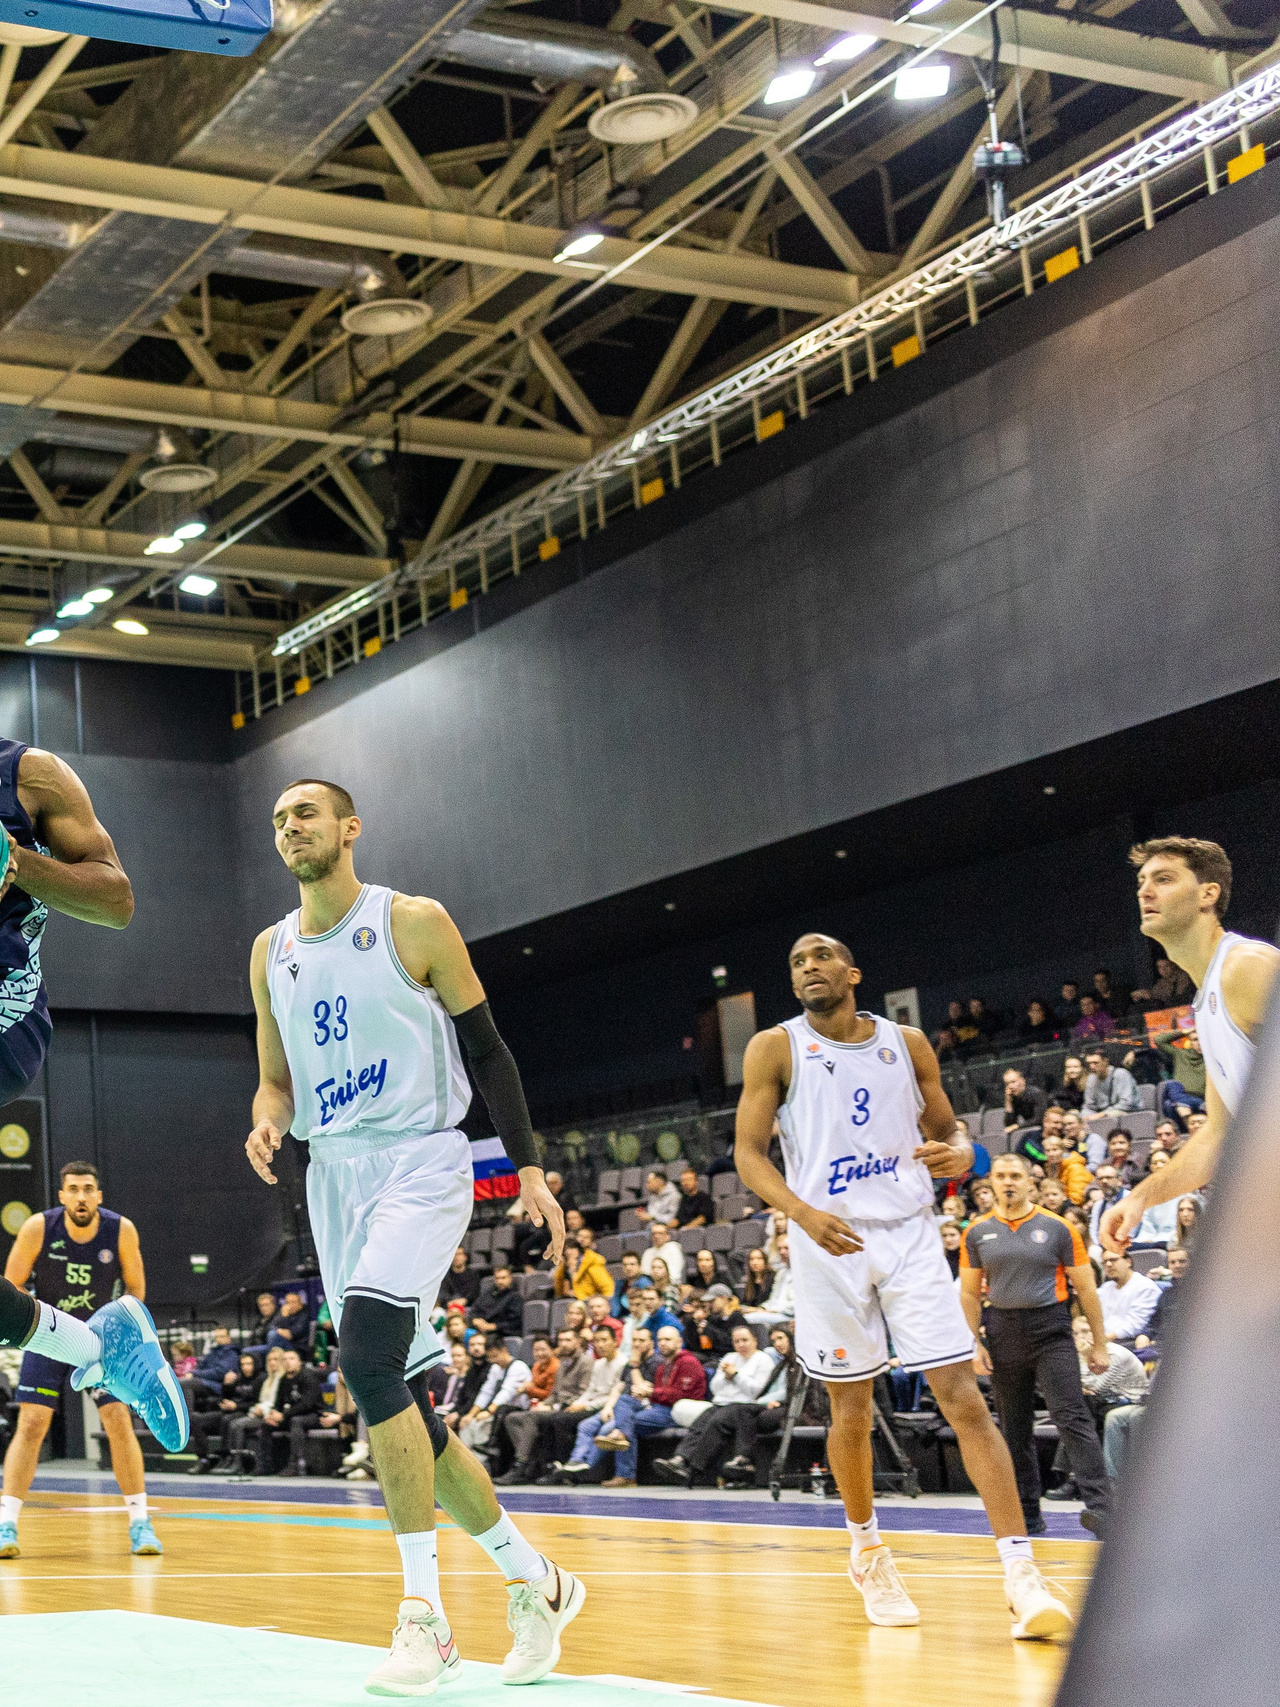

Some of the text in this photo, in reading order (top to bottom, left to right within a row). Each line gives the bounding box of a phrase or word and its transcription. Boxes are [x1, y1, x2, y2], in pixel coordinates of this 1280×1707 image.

[313, 995, 348, 1046] 33
[851, 1087, 870, 1126] 3
[65, 1262, 92, 1285] 55
